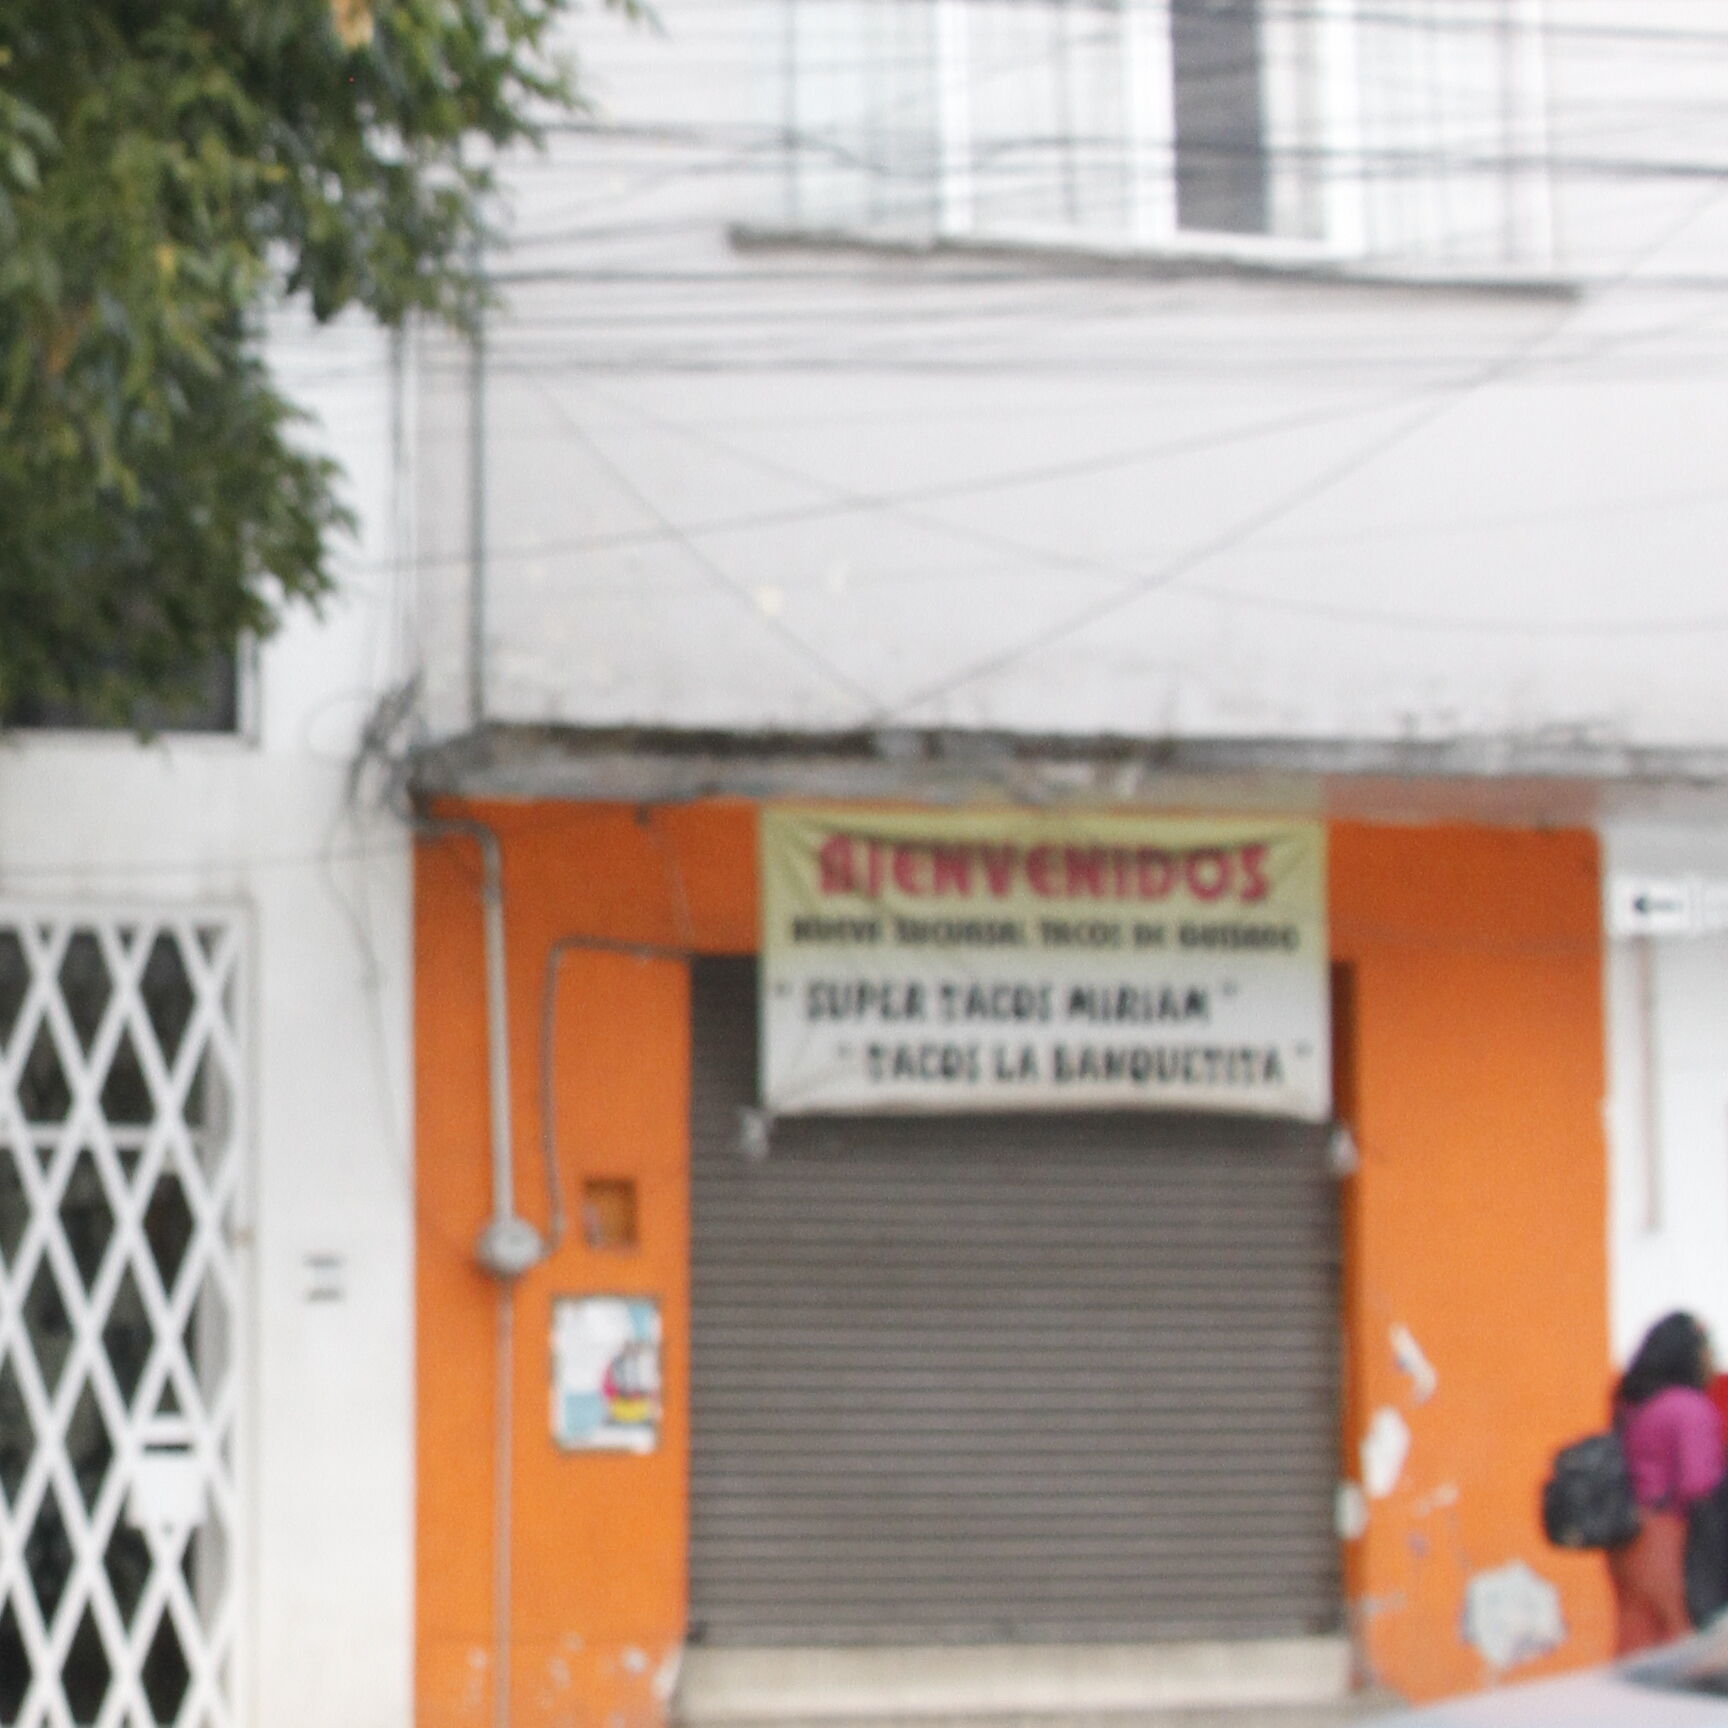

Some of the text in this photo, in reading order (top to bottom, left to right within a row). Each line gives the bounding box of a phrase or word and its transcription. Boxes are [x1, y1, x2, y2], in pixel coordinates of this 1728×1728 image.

[818, 834, 1272, 904] BIENVENIDOS
[805, 980, 1211, 1027] SUPER TACOS MIRIAM
[866, 1043, 980, 1085] TACOS
[994, 1045, 1039, 1082] LA
